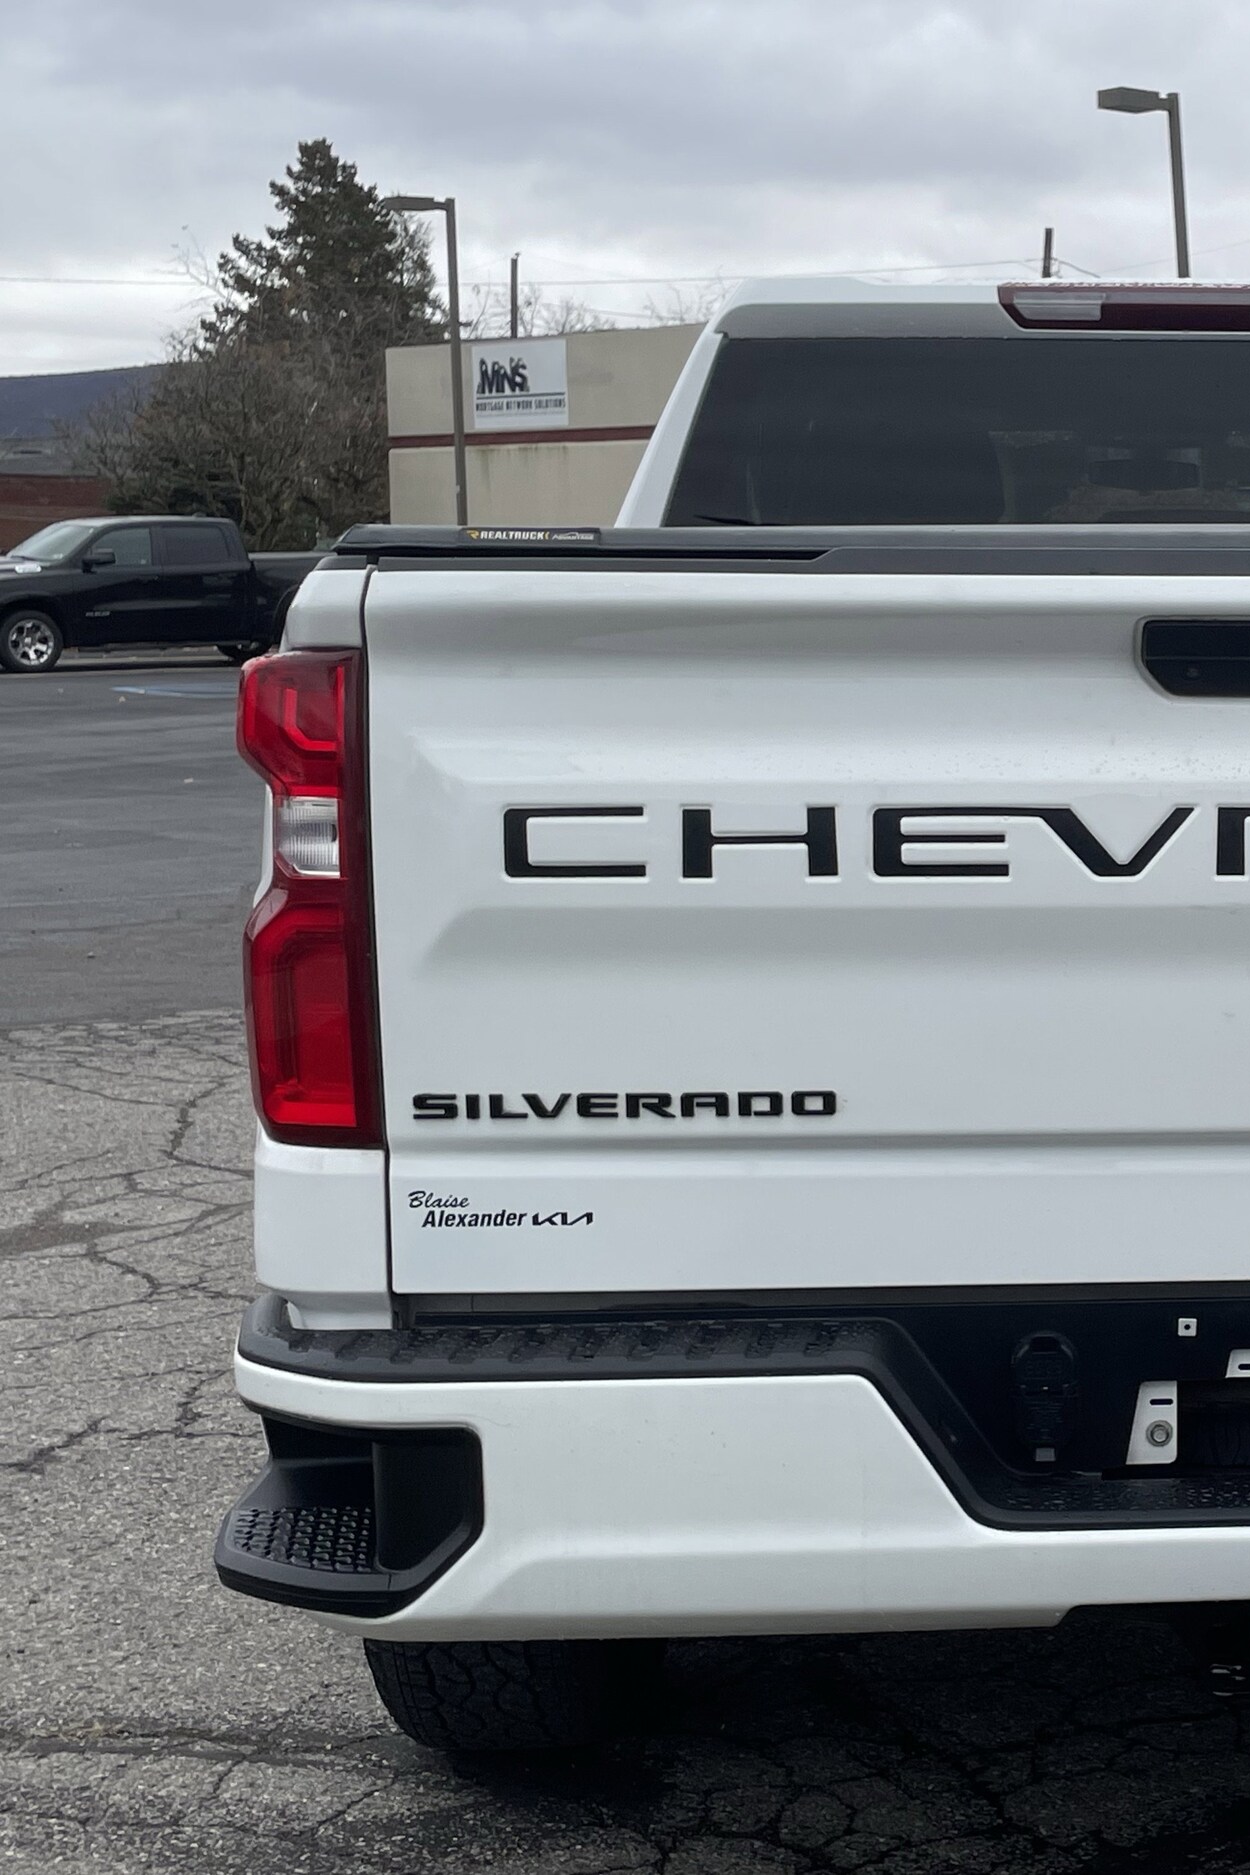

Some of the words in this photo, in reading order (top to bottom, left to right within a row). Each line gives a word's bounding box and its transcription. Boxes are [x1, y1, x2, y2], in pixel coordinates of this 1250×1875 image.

[476, 357, 530, 394] MNS
[475, 401, 504, 412] MORTGAGE
[506, 400, 533, 411] NETWORK
[534, 398, 566, 410] SOLUTIONS
[480, 530, 544, 540] REALTRUCK
[413, 1090, 837, 1119] SILVERADO
[408, 1190, 470, 1208] Blaise
[422, 1209, 528, 1228] Alexander
